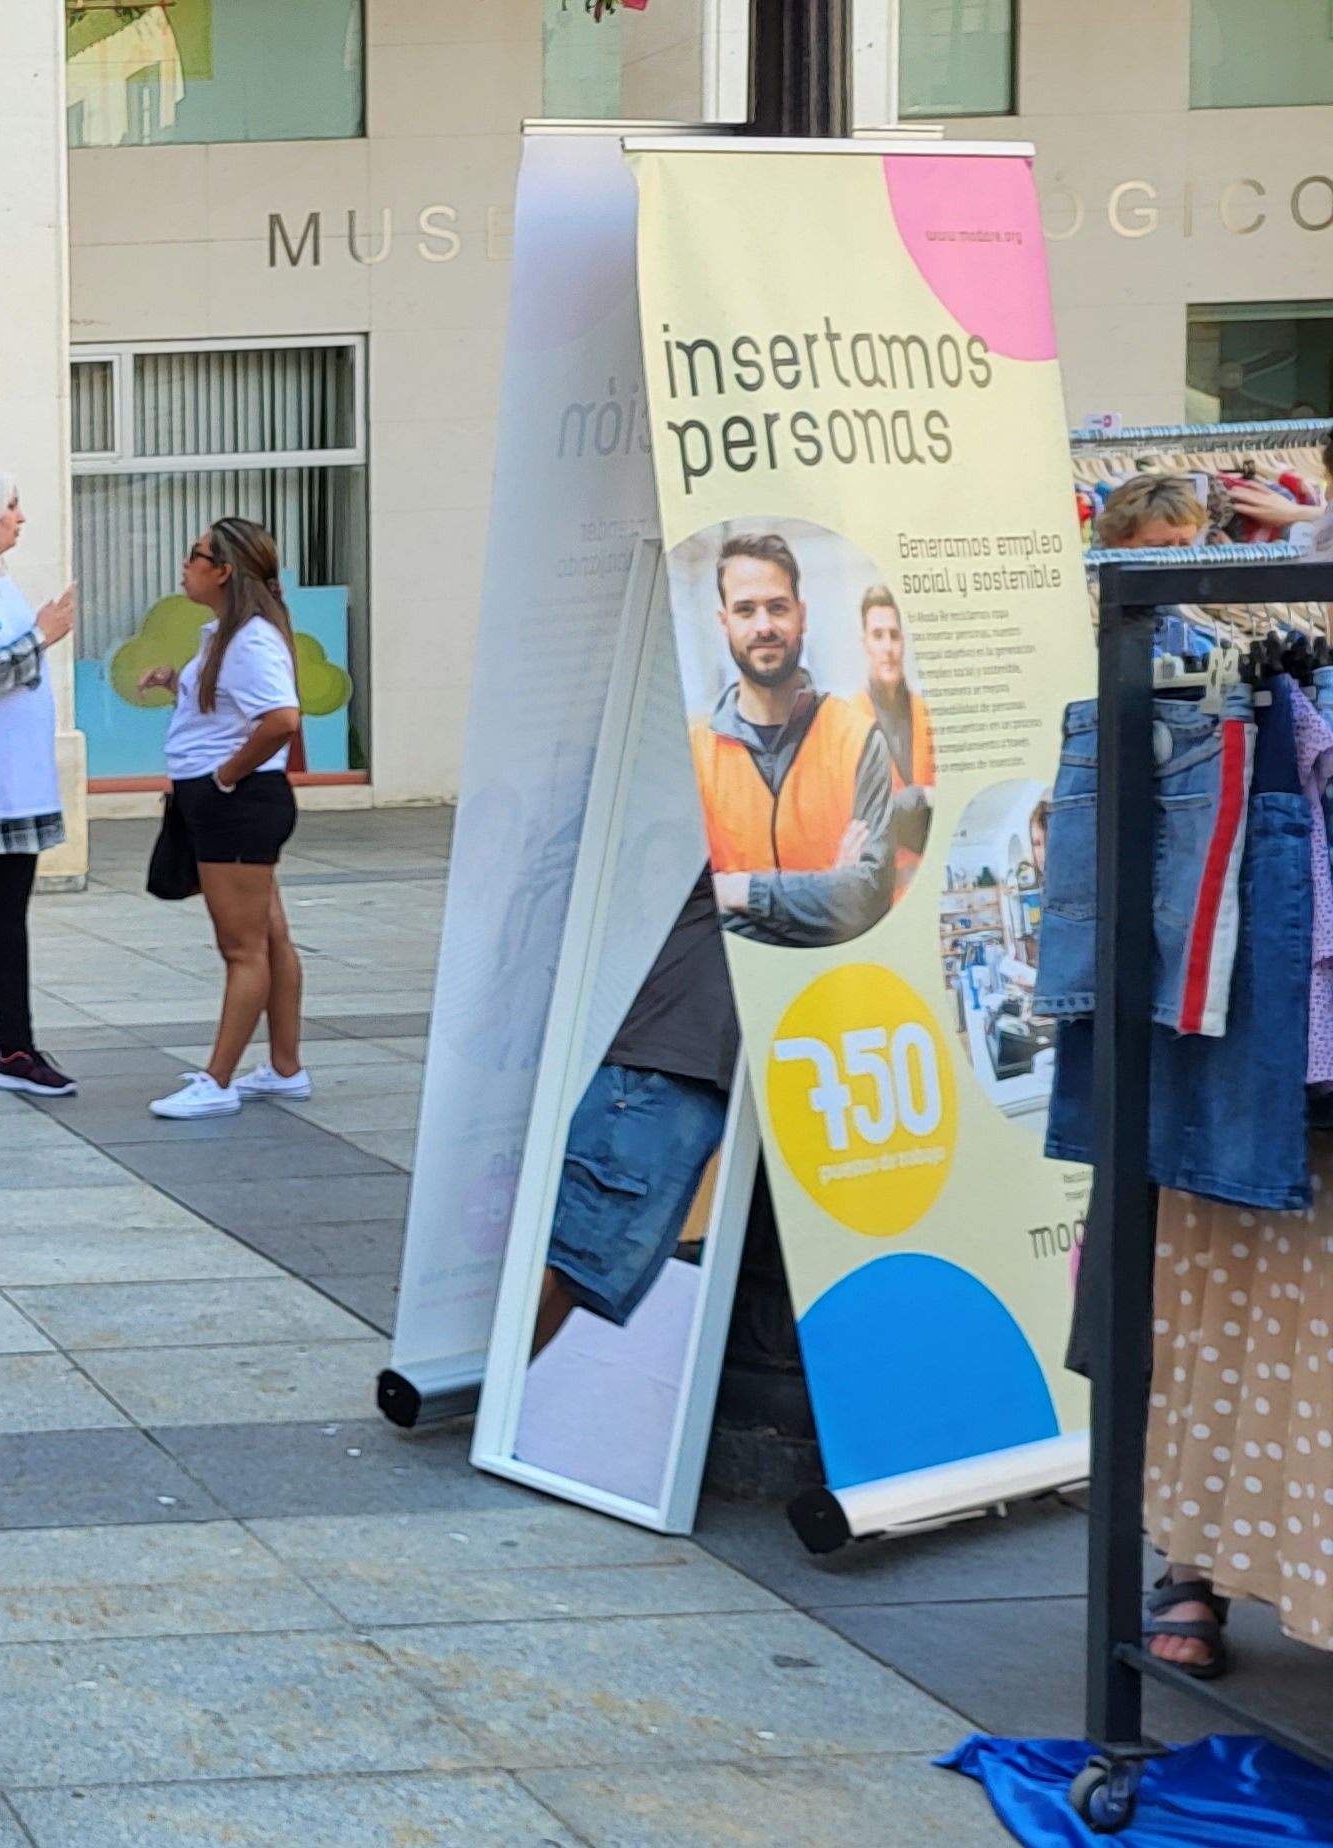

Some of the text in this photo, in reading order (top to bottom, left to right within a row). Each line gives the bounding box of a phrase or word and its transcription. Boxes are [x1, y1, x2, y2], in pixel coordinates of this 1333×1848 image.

[267, 205, 514, 268] MUSE
[662, 316, 993, 399] insertamos
[666, 409, 953, 495] personas
[898, 530, 1063, 560] Generamos empleo
[902, 563, 1062, 598] social y sostenible
[774, 1022, 944, 1151] 750
[1027, 1210, 1088, 1260] mod
